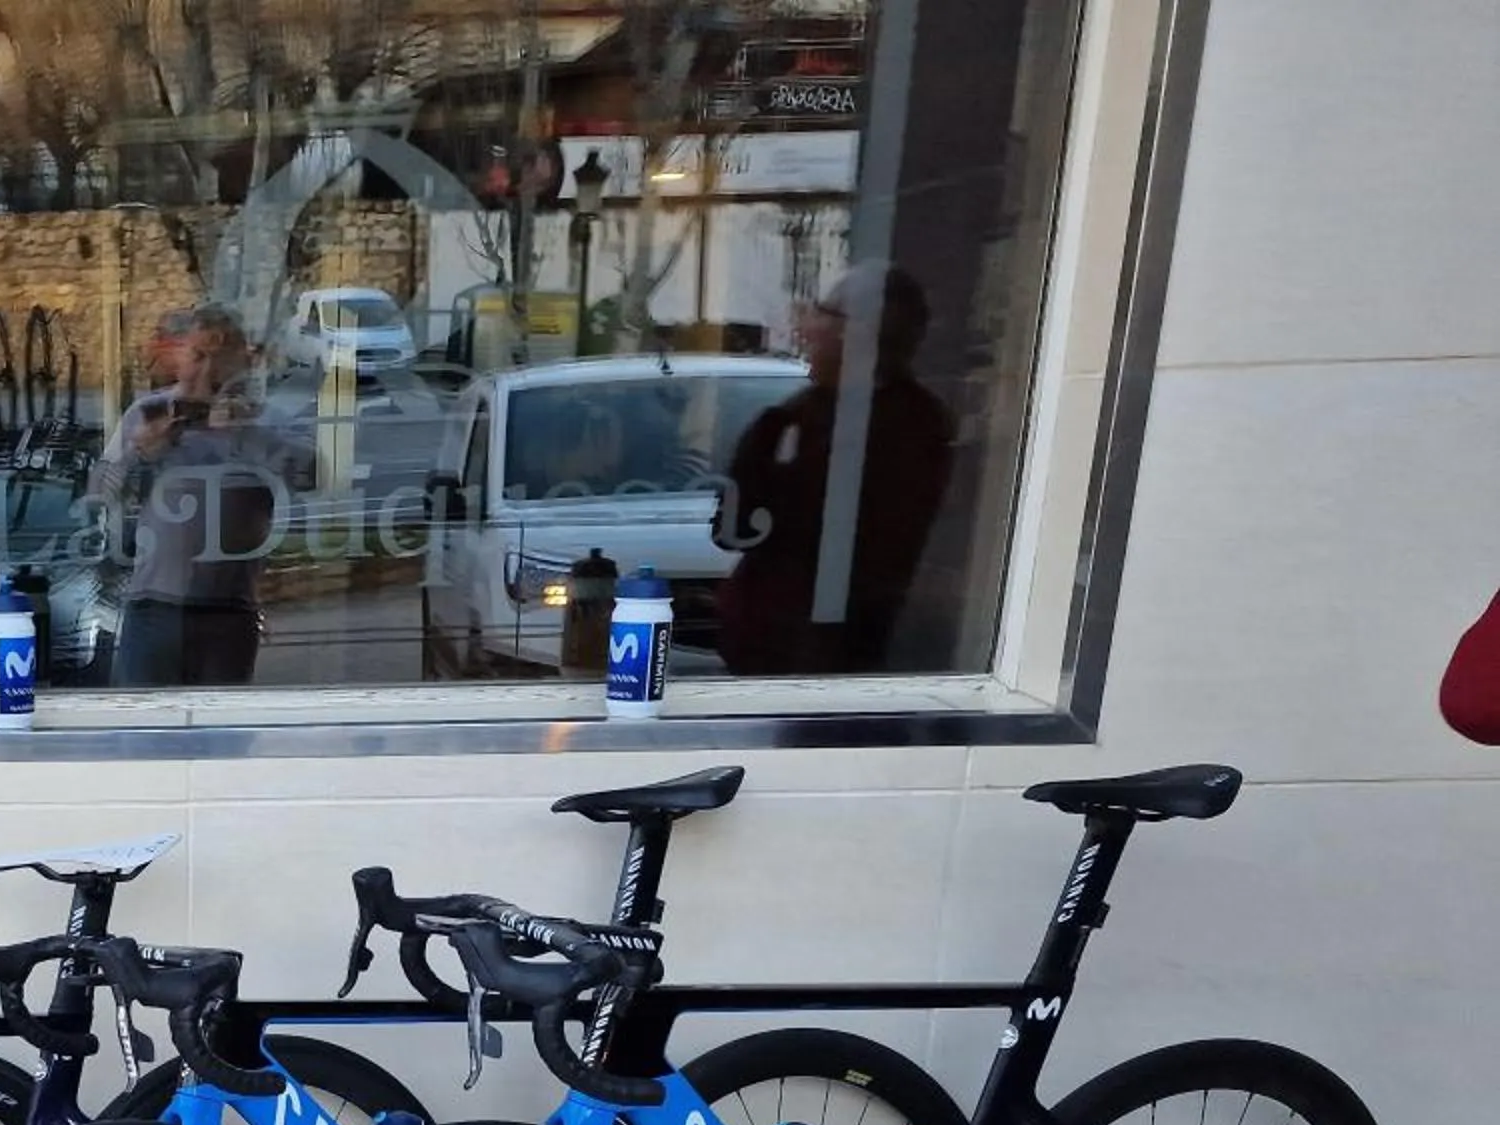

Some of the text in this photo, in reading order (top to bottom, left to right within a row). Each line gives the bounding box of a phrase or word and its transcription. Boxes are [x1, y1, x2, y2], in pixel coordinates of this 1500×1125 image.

[653, 629, 668, 696] GARMIN
[619, 847, 645, 921] CANYON
[1057, 843, 1101, 923] CANYON
